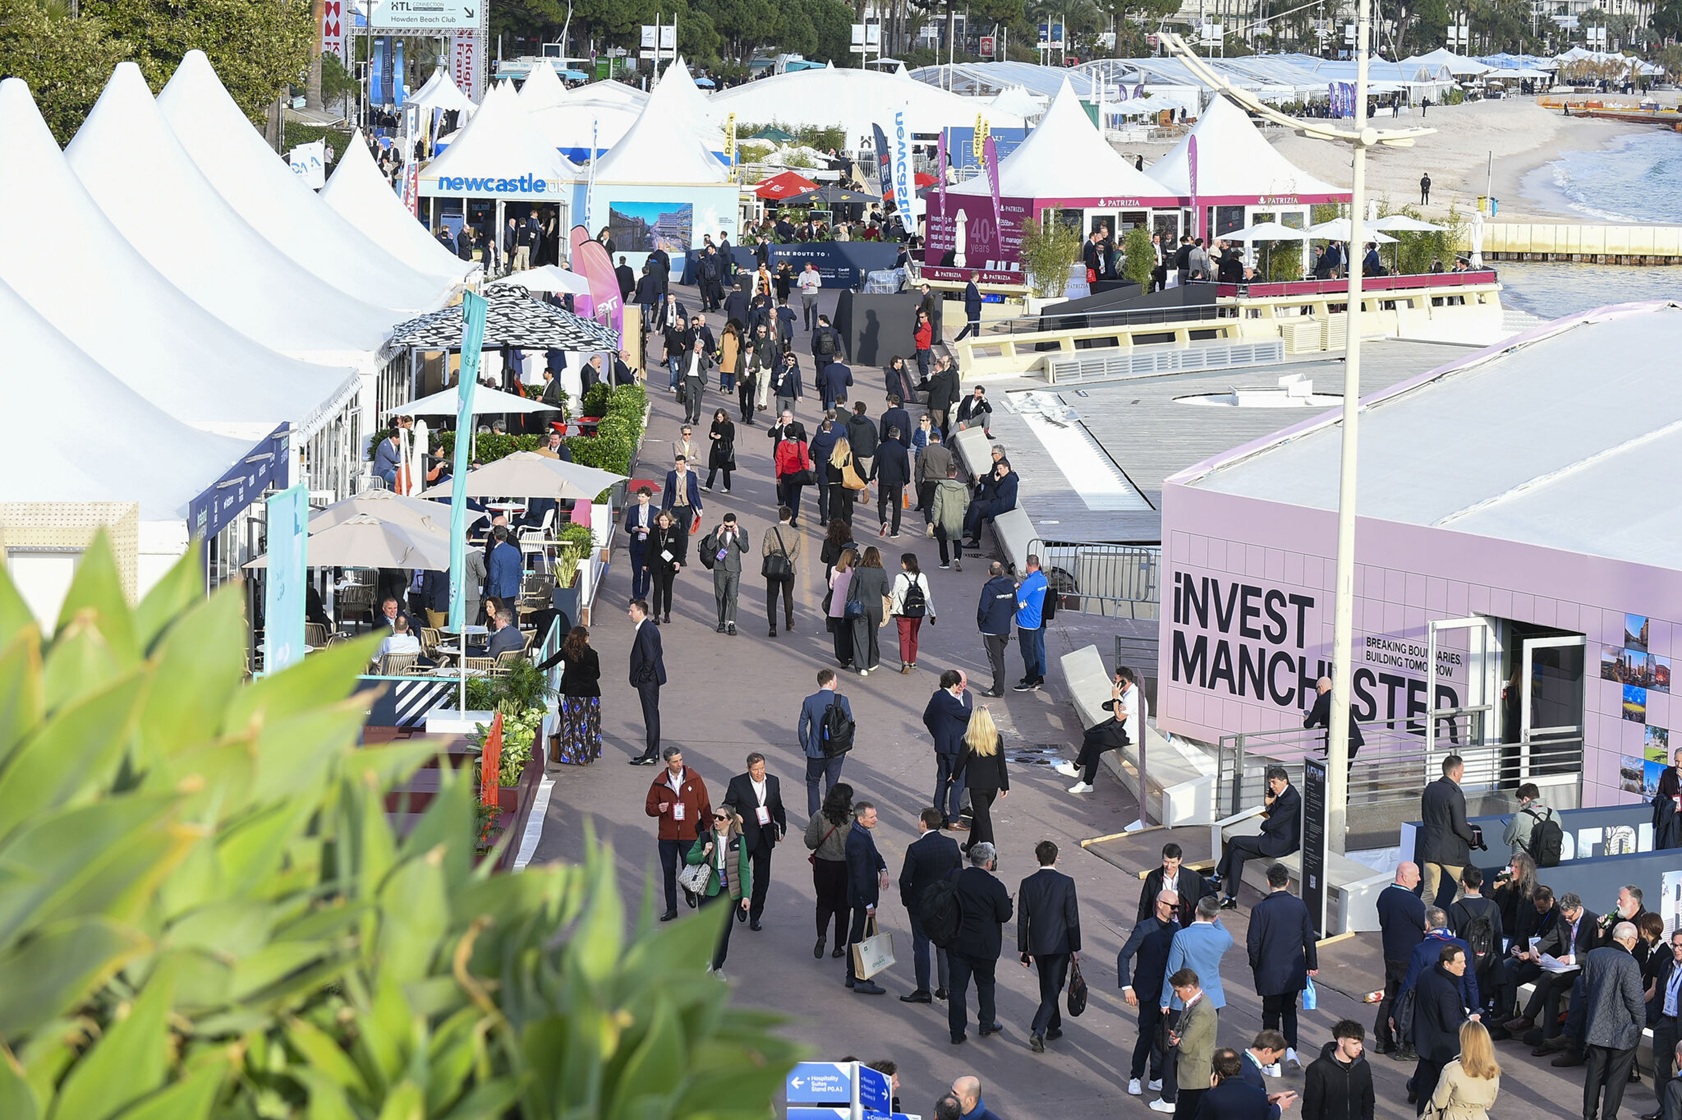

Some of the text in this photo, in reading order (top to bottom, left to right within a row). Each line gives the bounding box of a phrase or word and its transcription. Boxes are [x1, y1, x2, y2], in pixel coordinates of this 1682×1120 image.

[438, 172, 546, 193] newcastle
[1107, 199, 1140, 207] PATRIZIA
[1267, 197, 1298, 205] PATRIZIA
[1005, 205, 1024, 213] PATRIZIA
[970, 244, 990, 254] years
[989, 273, 1011, 281] PATRIZIA
[1366, 637, 1463, 667] BREAKING BOUARIES,
[1366, 650, 1454, 677] BUILDING TOMOROW
[1172, 630, 1460, 744] MANCHSTER
